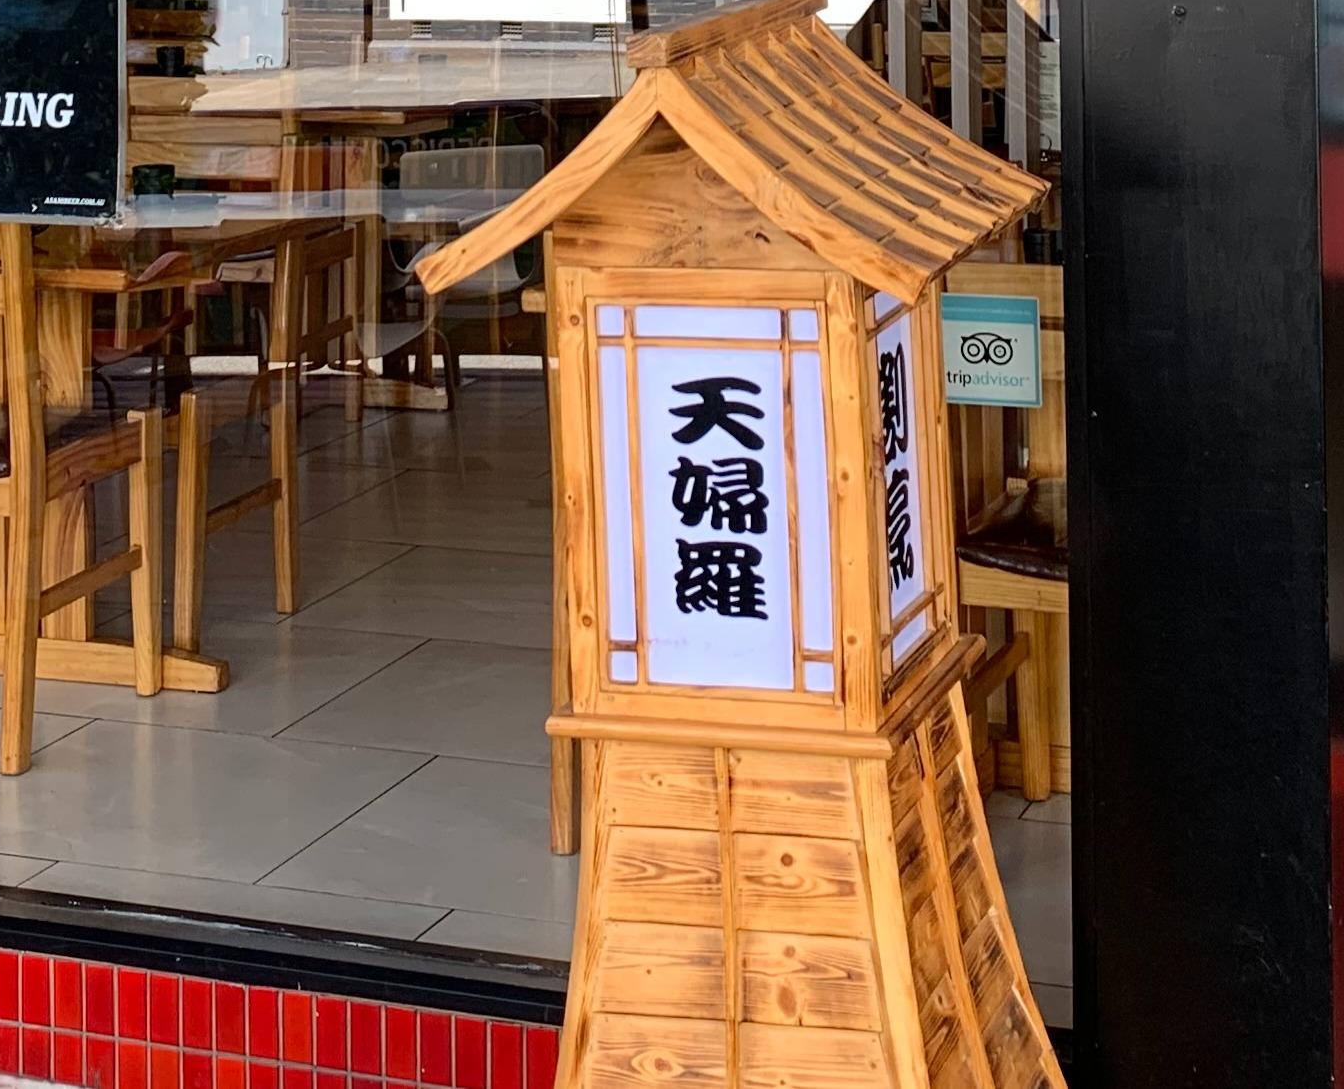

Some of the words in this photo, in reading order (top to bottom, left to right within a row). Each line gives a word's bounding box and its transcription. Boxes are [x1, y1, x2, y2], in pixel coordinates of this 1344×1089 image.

[946, 370, 1026, 387] tripadvisor
[668, 376, 769, 621] 天婦羅
